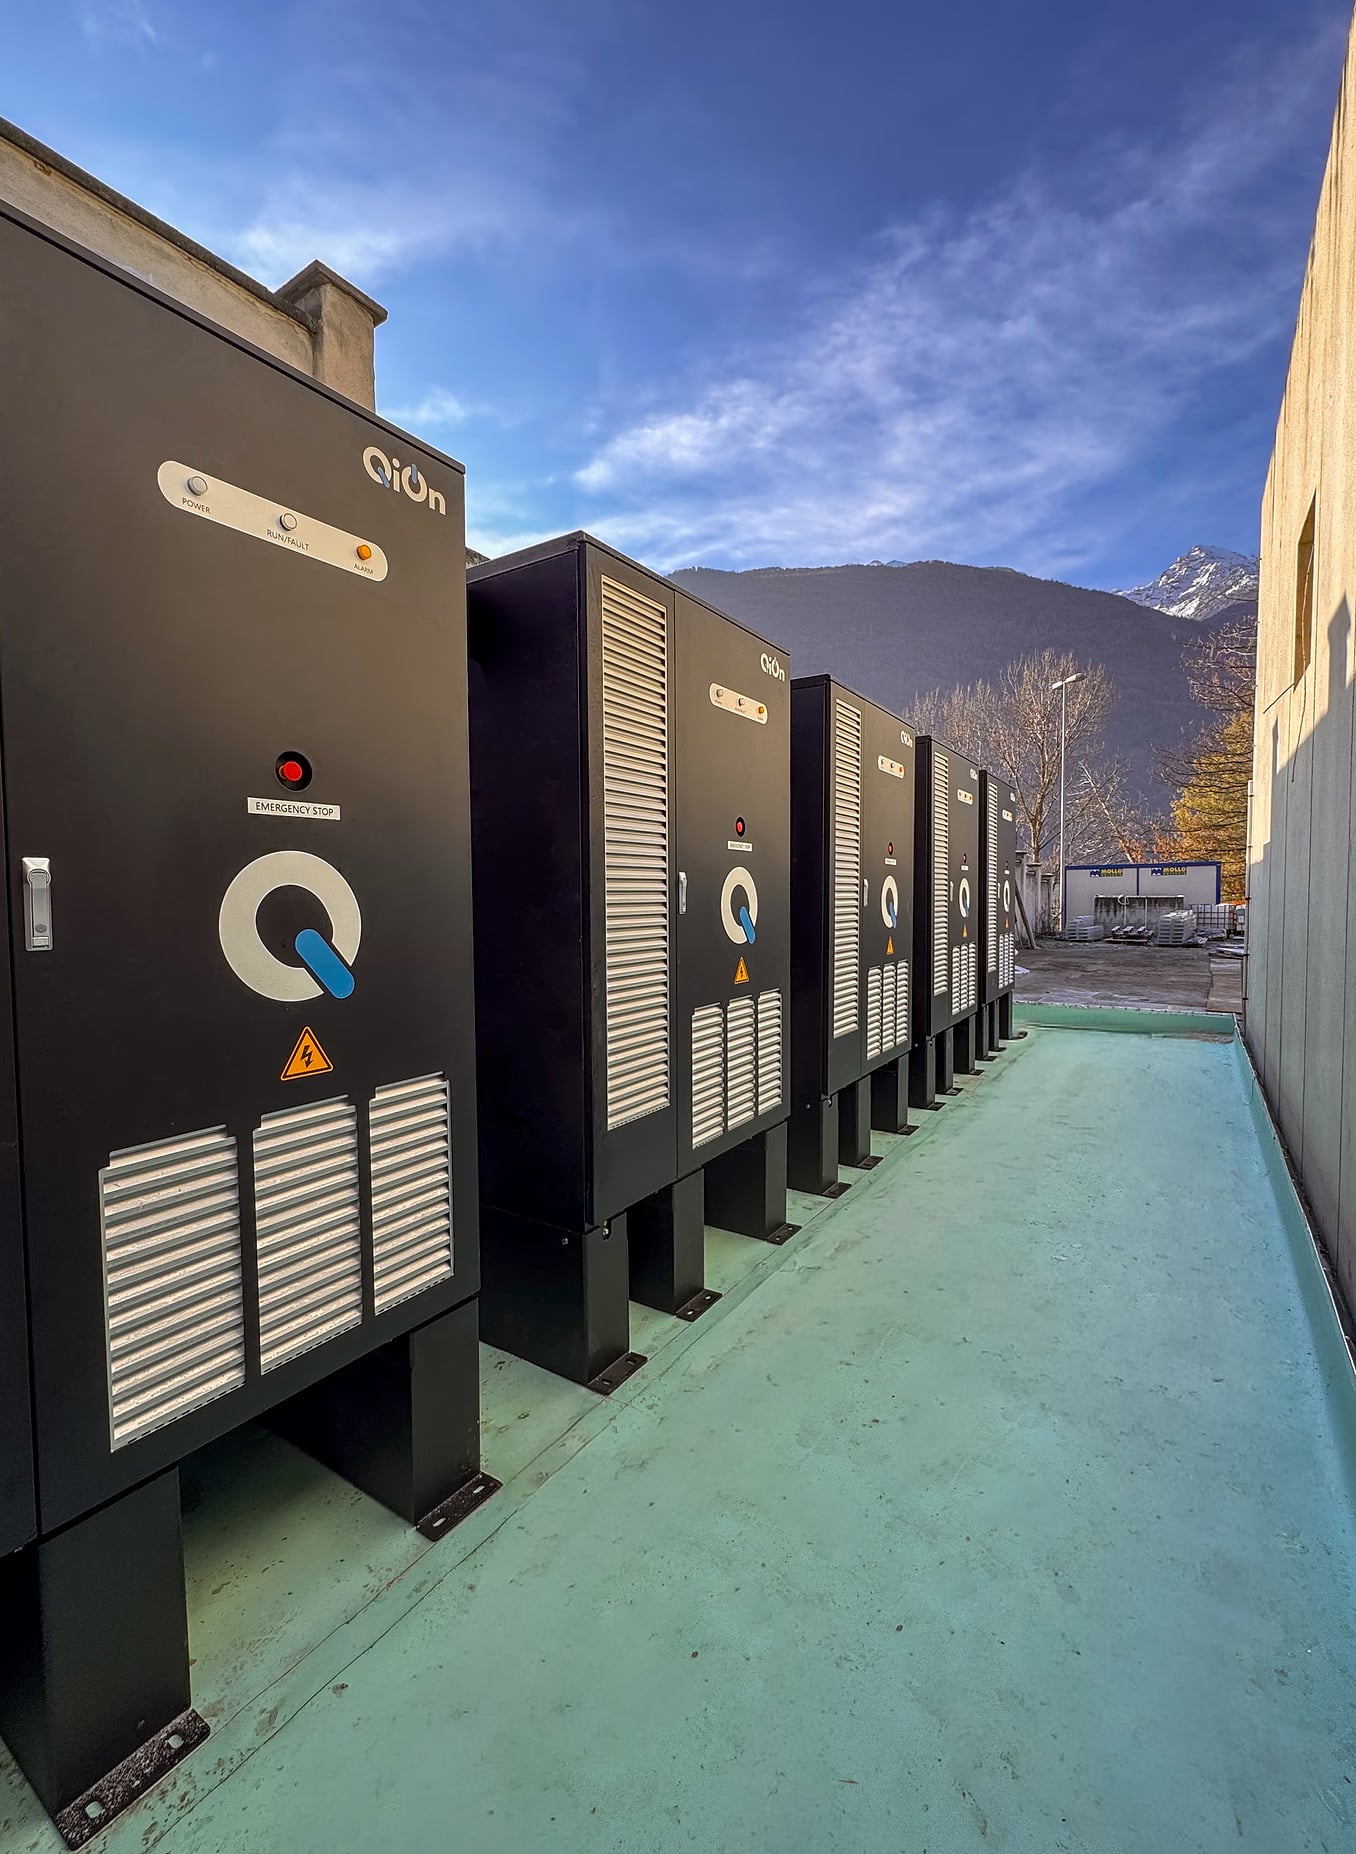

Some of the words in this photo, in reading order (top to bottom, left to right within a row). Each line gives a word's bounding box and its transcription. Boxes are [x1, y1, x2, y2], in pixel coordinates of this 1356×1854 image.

[362, 446, 447, 516] QiOn
[182, 497, 211, 515] POWER
[266, 529, 310, 551] RUN/FAULT
[353, 563, 374, 576] ALARM
[255, 801, 310, 815] EMERGENCY
[312, 806, 334, 817] STOP
